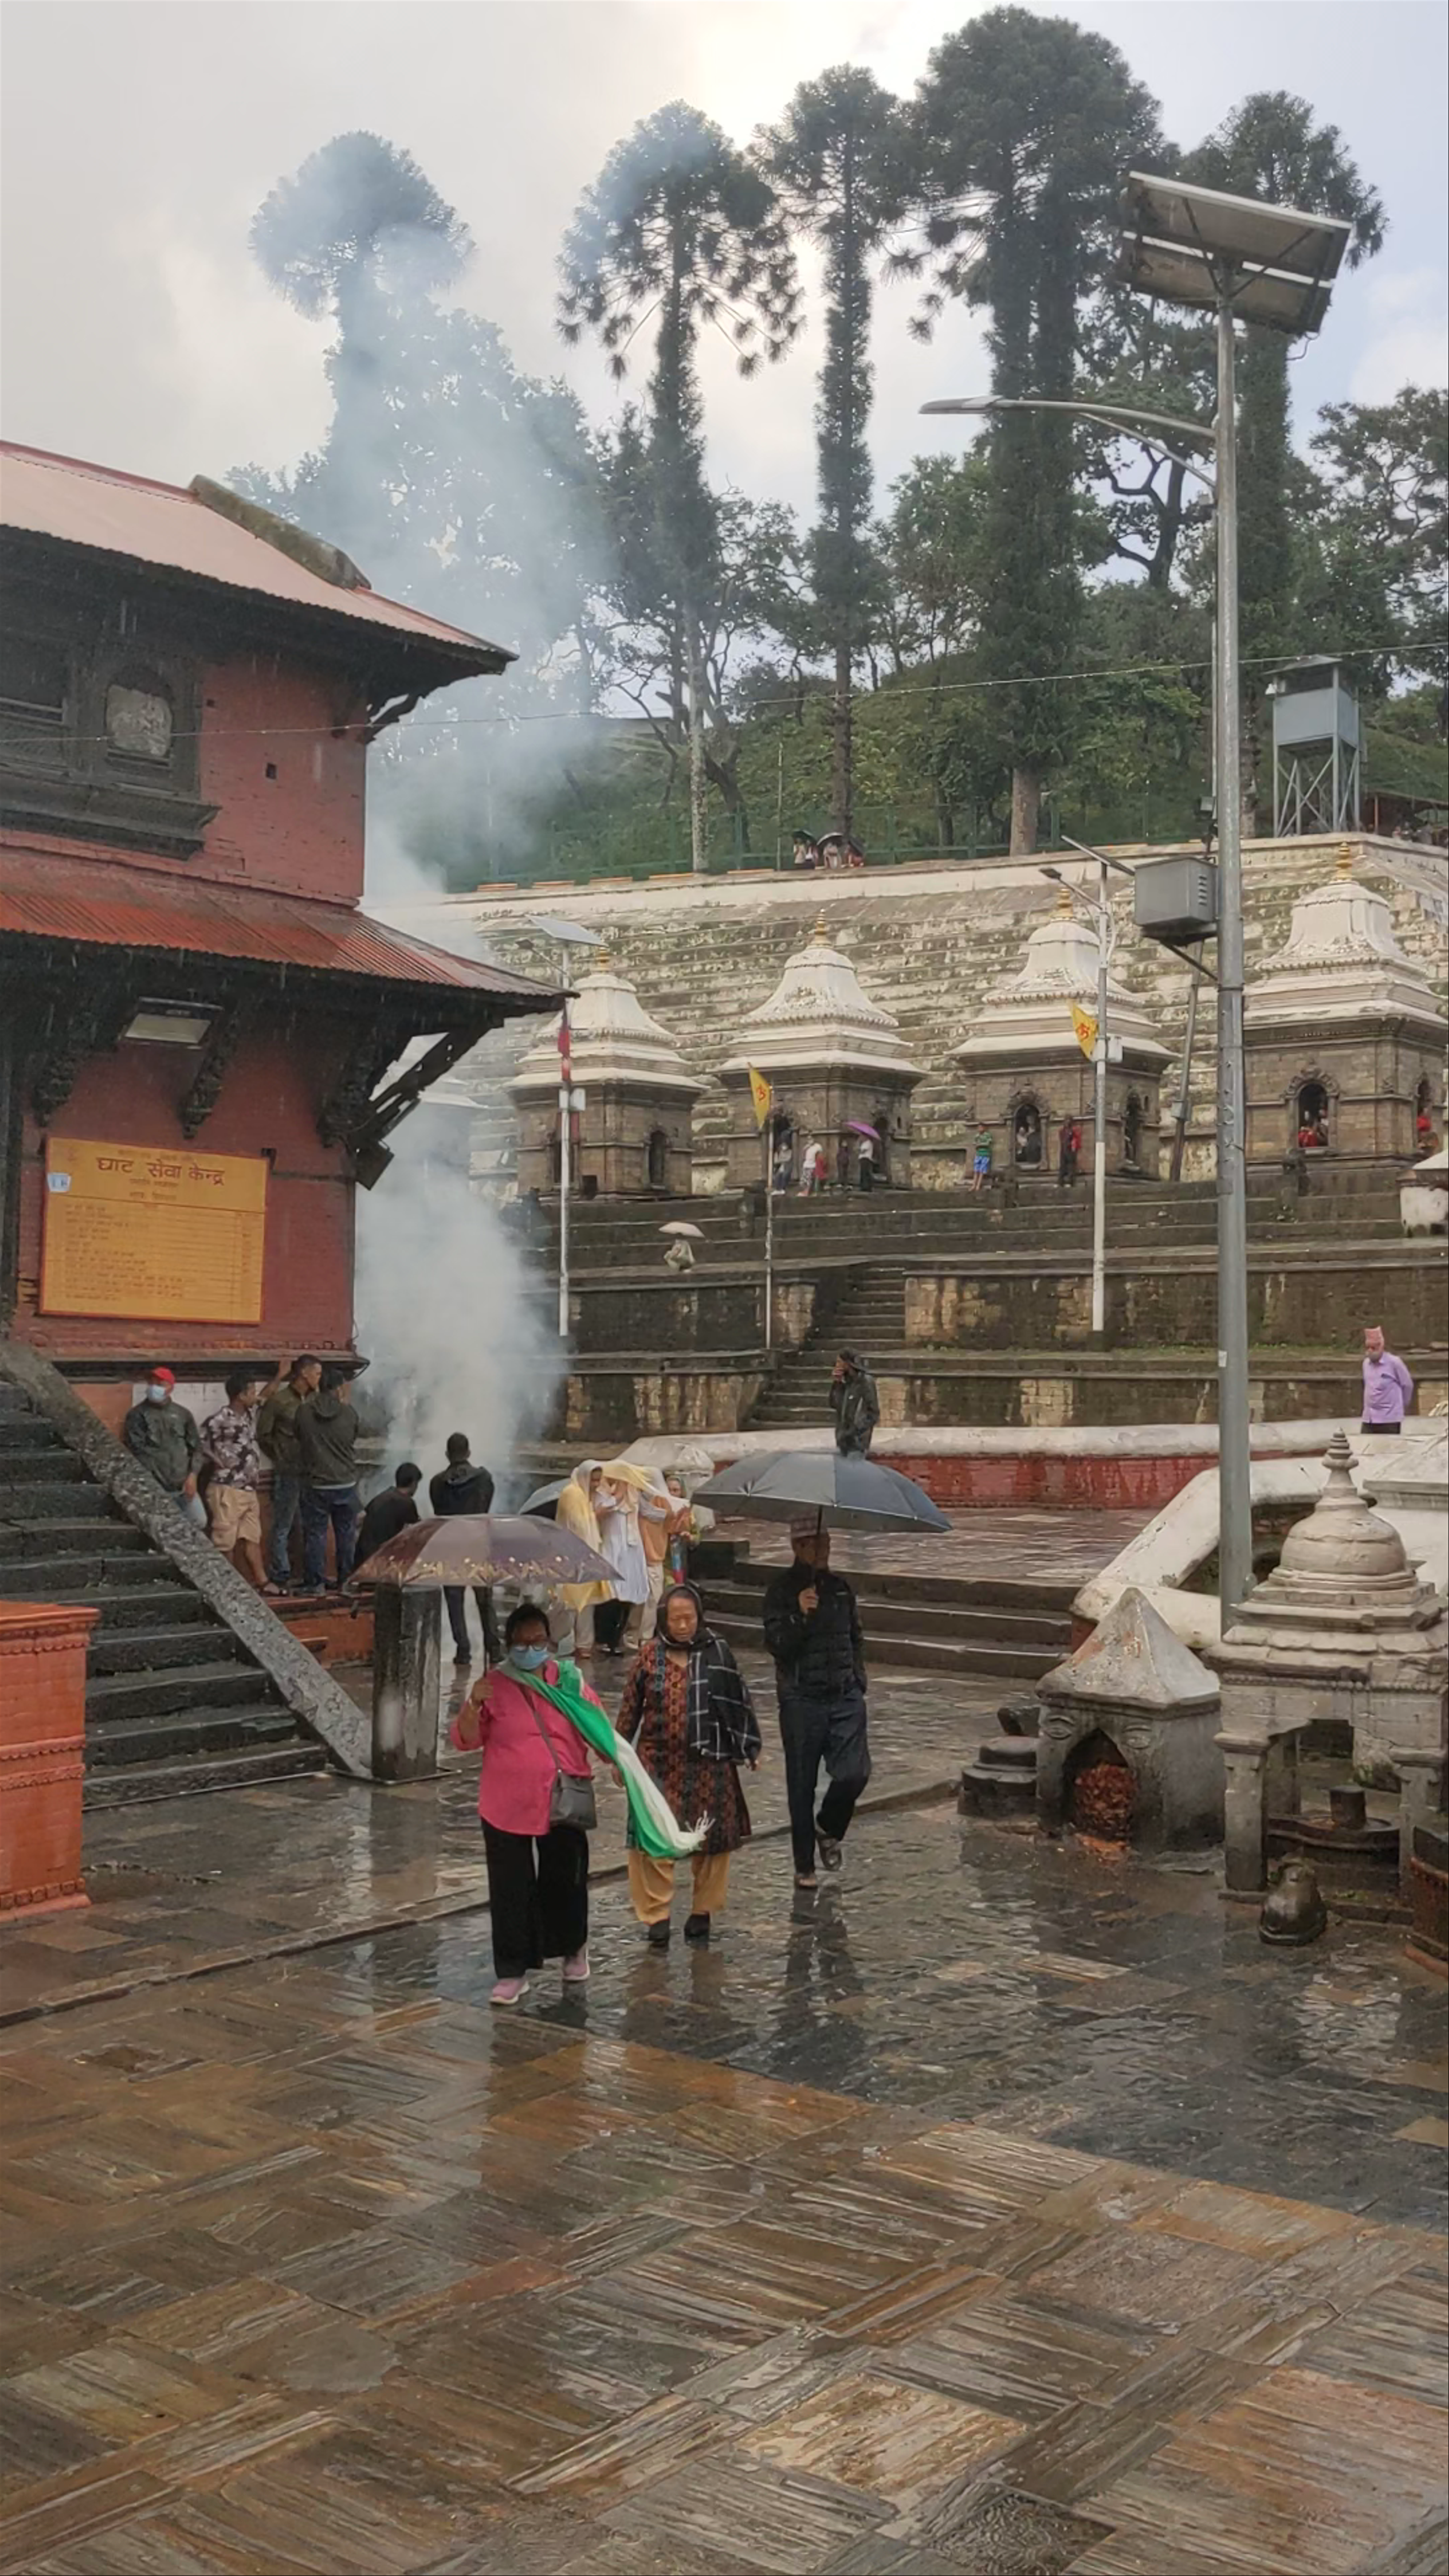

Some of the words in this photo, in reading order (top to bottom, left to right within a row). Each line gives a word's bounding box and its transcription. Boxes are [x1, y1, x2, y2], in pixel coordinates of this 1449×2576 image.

[96, 1157, 134, 1172] घाट
[146, 1158, 182, 1178] सेवा
[188, 1162, 225, 1186] केन्द्र
